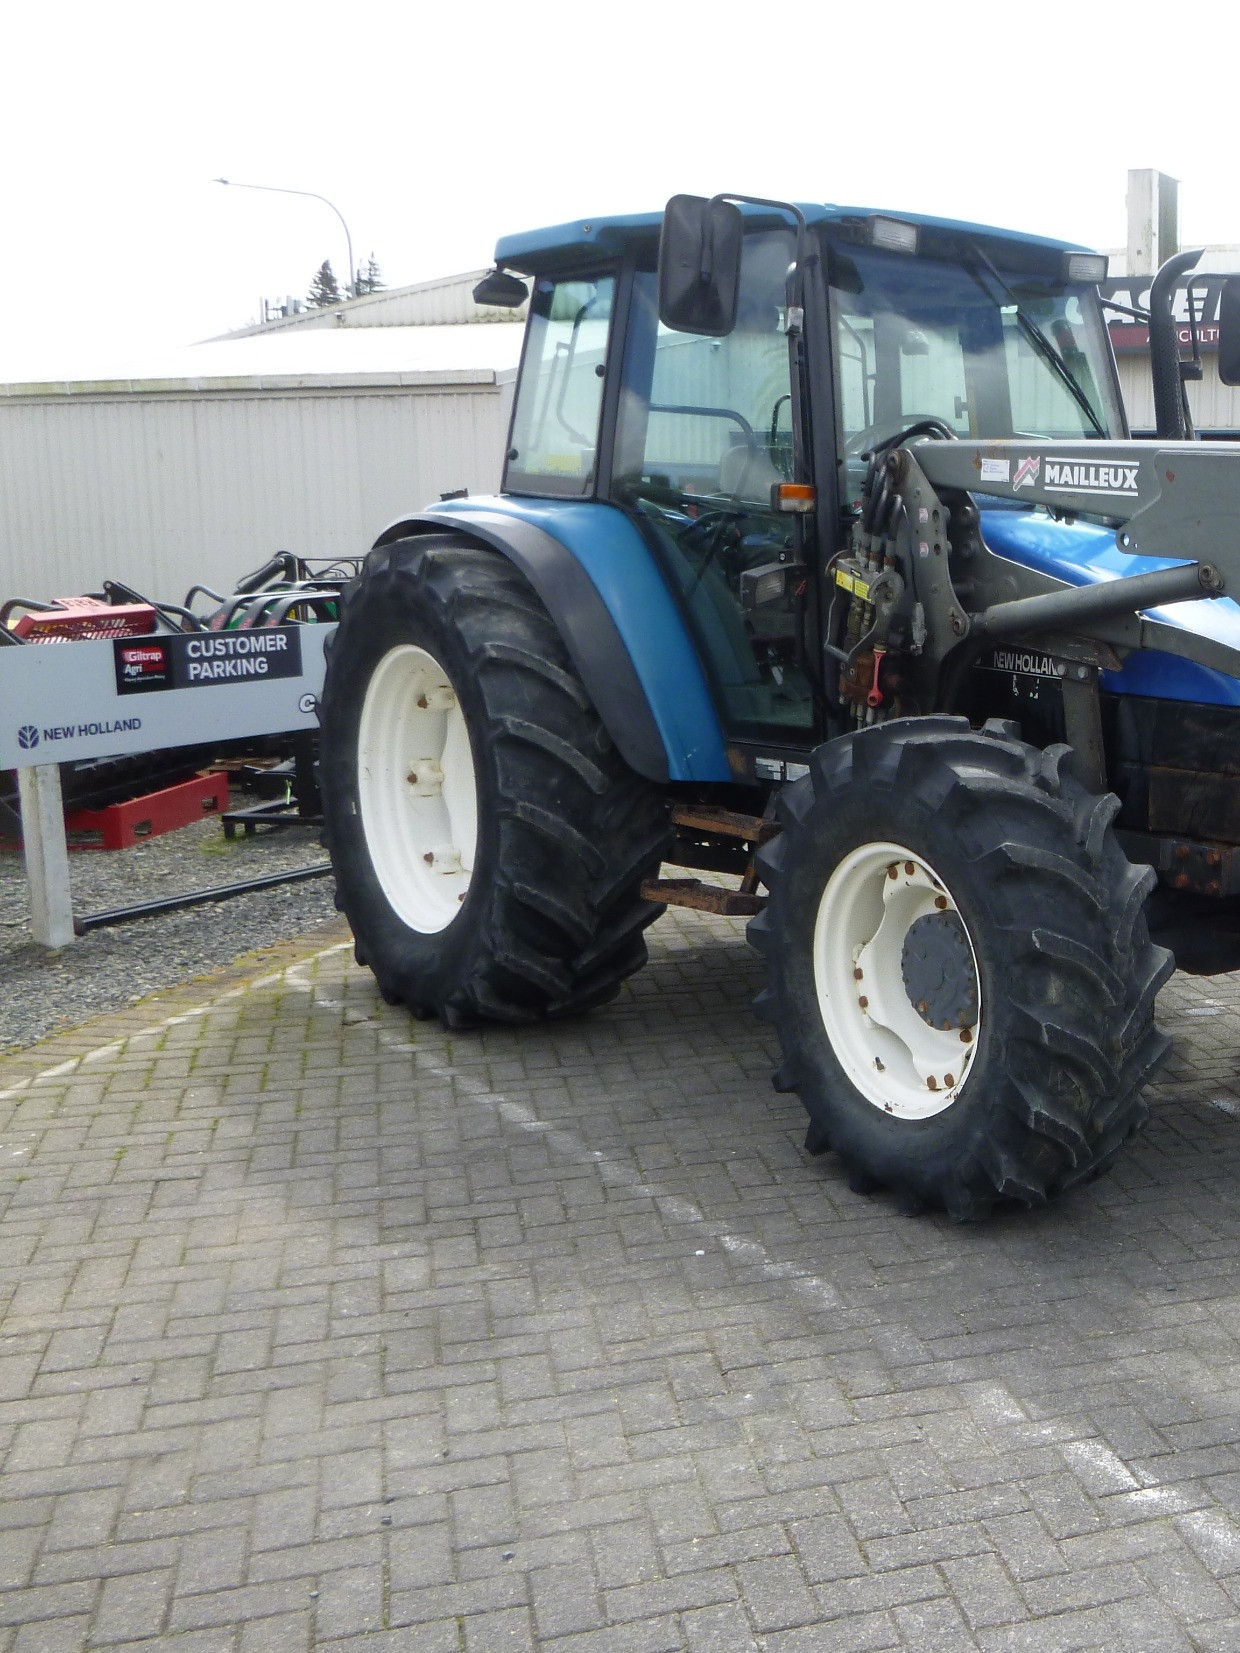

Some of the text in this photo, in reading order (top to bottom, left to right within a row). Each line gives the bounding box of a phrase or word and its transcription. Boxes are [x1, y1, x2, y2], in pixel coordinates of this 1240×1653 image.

[1044, 464, 1139, 489] MAILLEUX
[129, 650, 162, 662] Giltrap
[187, 634, 287, 658] CUSTOMER
[124, 663, 143, 676] Agri
[188, 657, 269, 680] PARKING
[993, 650, 1059, 677] NEW HOLLAN
[43, 718, 142, 741] NEW HOLLAND
